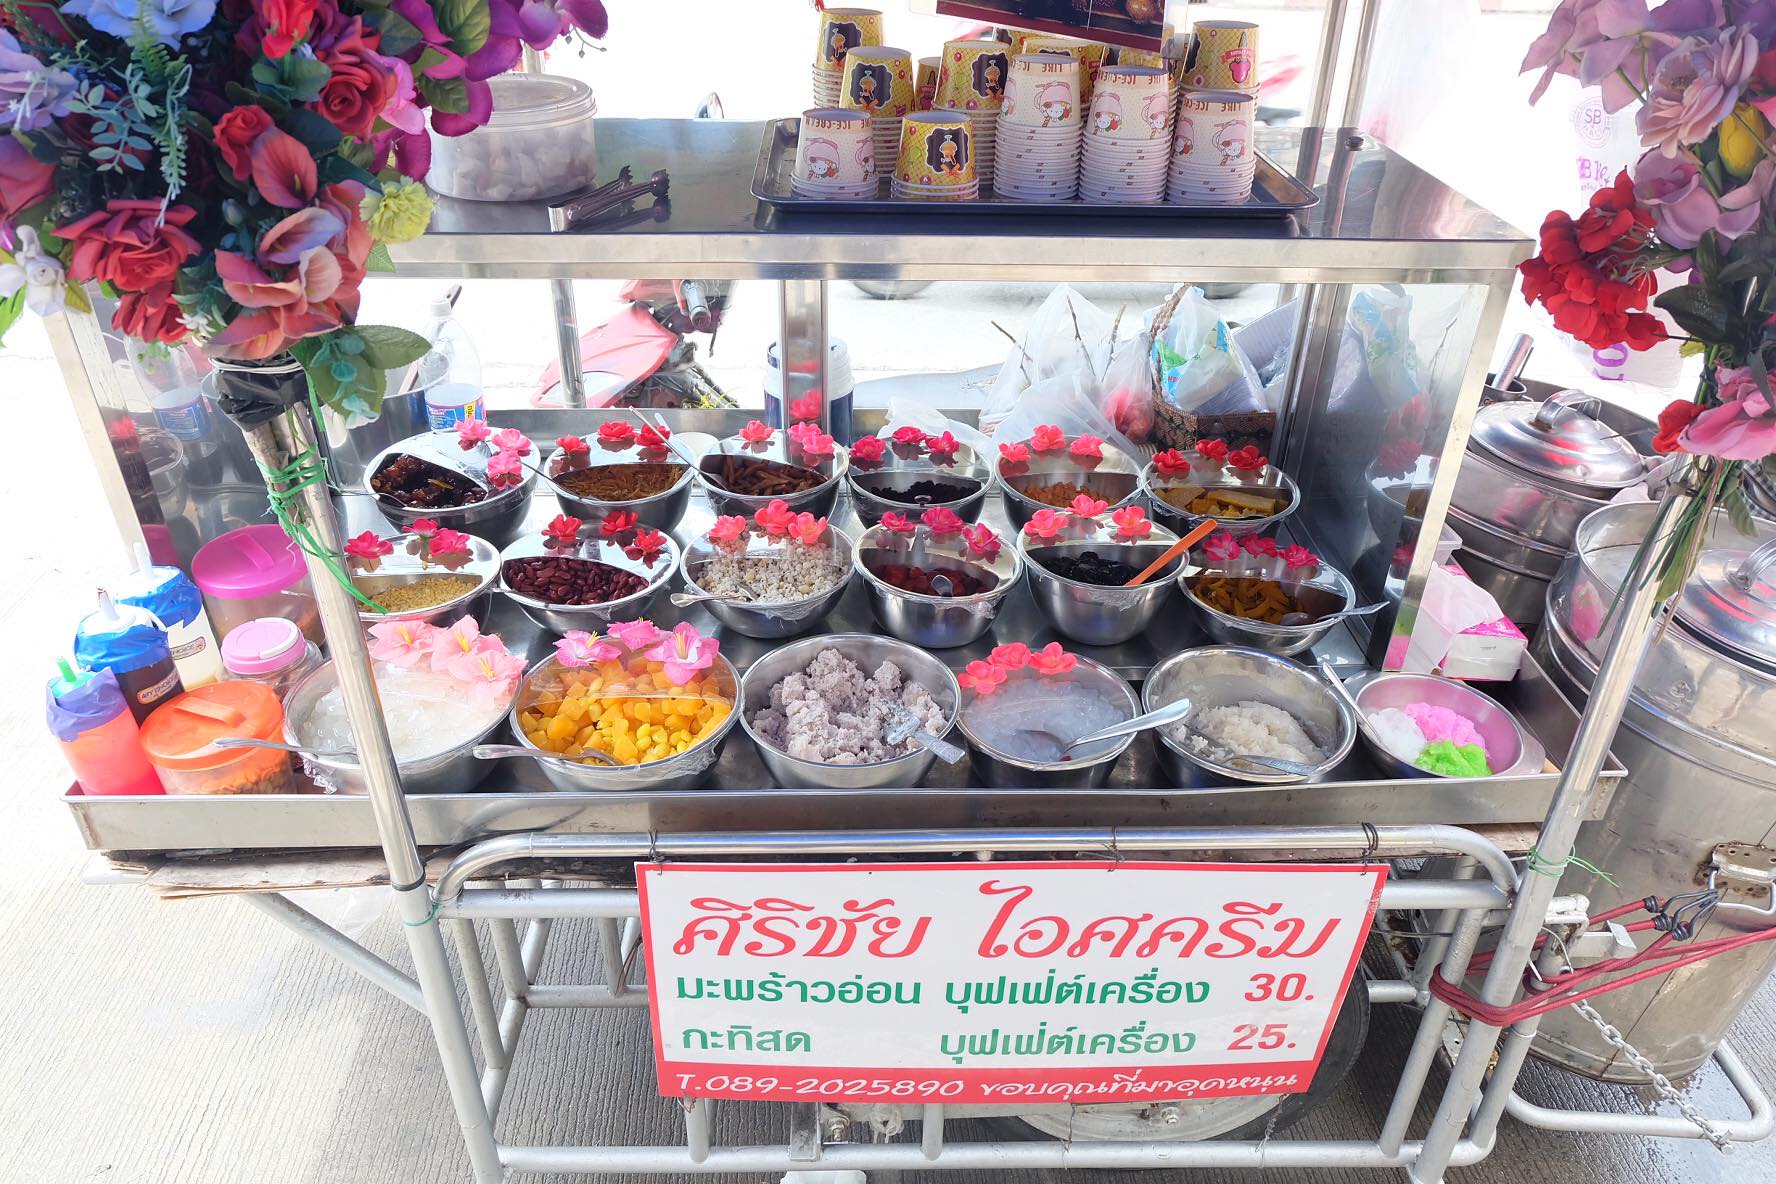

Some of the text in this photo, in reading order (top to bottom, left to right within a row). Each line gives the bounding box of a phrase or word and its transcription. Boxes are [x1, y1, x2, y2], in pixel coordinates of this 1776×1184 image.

[672, 879, 1342, 959] ศิริชัย ไอศครีม
[676, 967, 1314, 1014] มะพร้าวอ่อน บุฟเฟ่ต์เครื่อง 30.
[681, 1020, 1297, 1065] กะทิสด บุฟเฟ่ต์เครื่อง 25.
[980, 1068, 1298, 1100] ขอบคุณที่มาอุดหนุน
